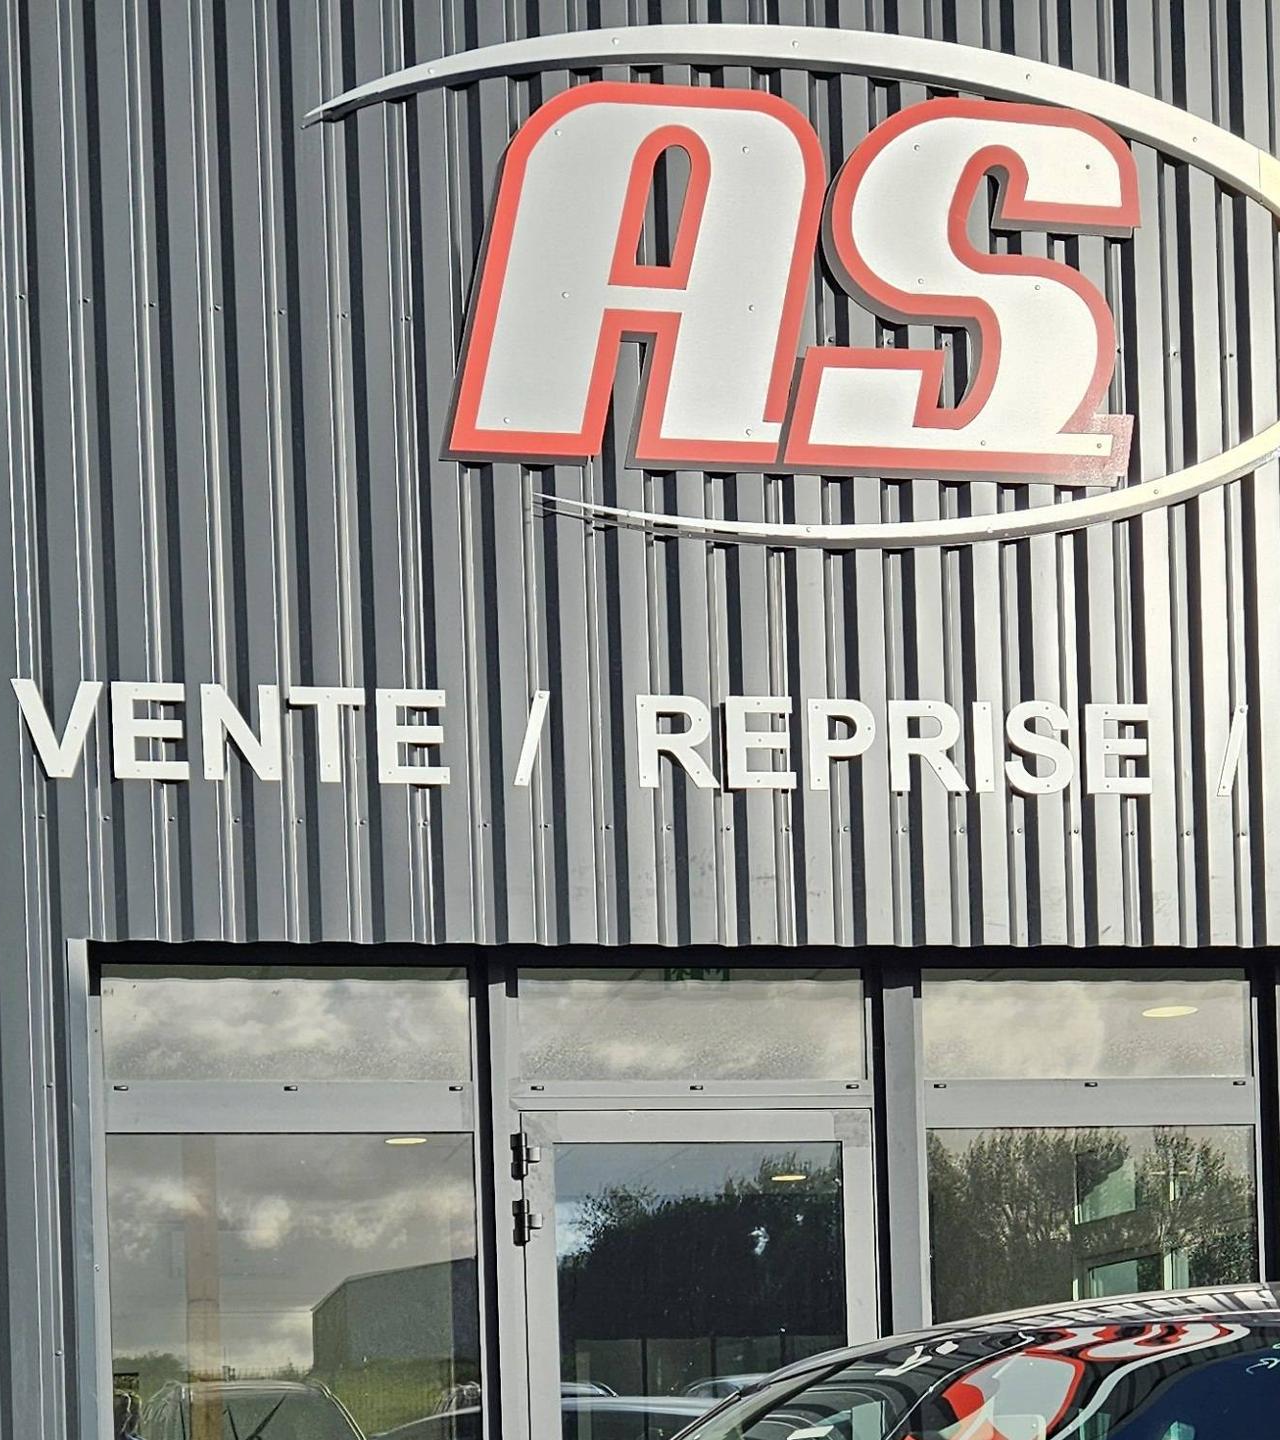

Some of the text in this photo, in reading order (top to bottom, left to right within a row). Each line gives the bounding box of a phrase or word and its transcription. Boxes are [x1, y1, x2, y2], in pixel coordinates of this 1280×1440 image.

[448, 80, 1142, 478] AS
[10, 677, 451, 786] VENTE
[513, 689, 551, 787] /
[636, 692, 1153, 796] REPRISE
[1217, 703, 1250, 798] /
